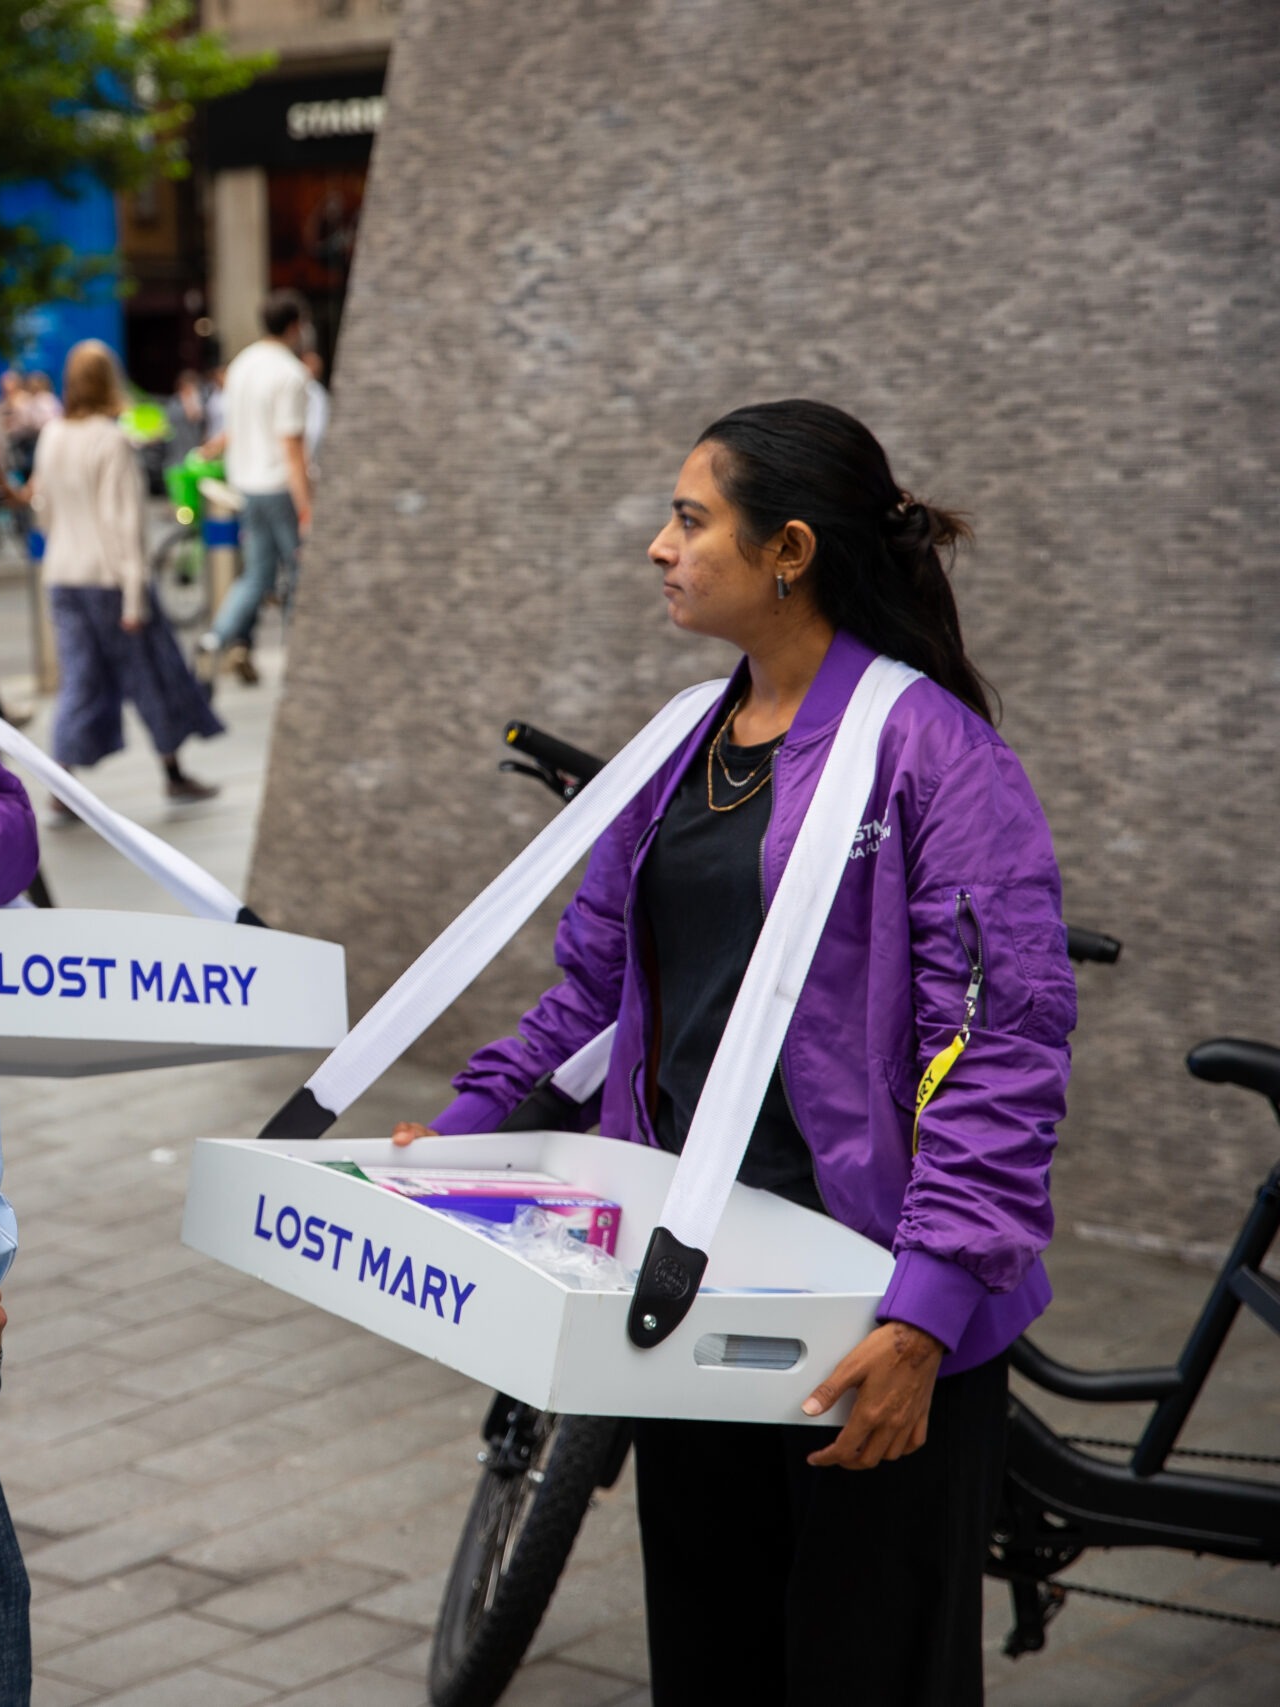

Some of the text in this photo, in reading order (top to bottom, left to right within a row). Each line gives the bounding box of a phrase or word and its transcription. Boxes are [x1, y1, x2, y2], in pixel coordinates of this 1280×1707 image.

[130, 959, 257, 1006] MARY
[254, 1194, 477, 1325] LOST MARY
